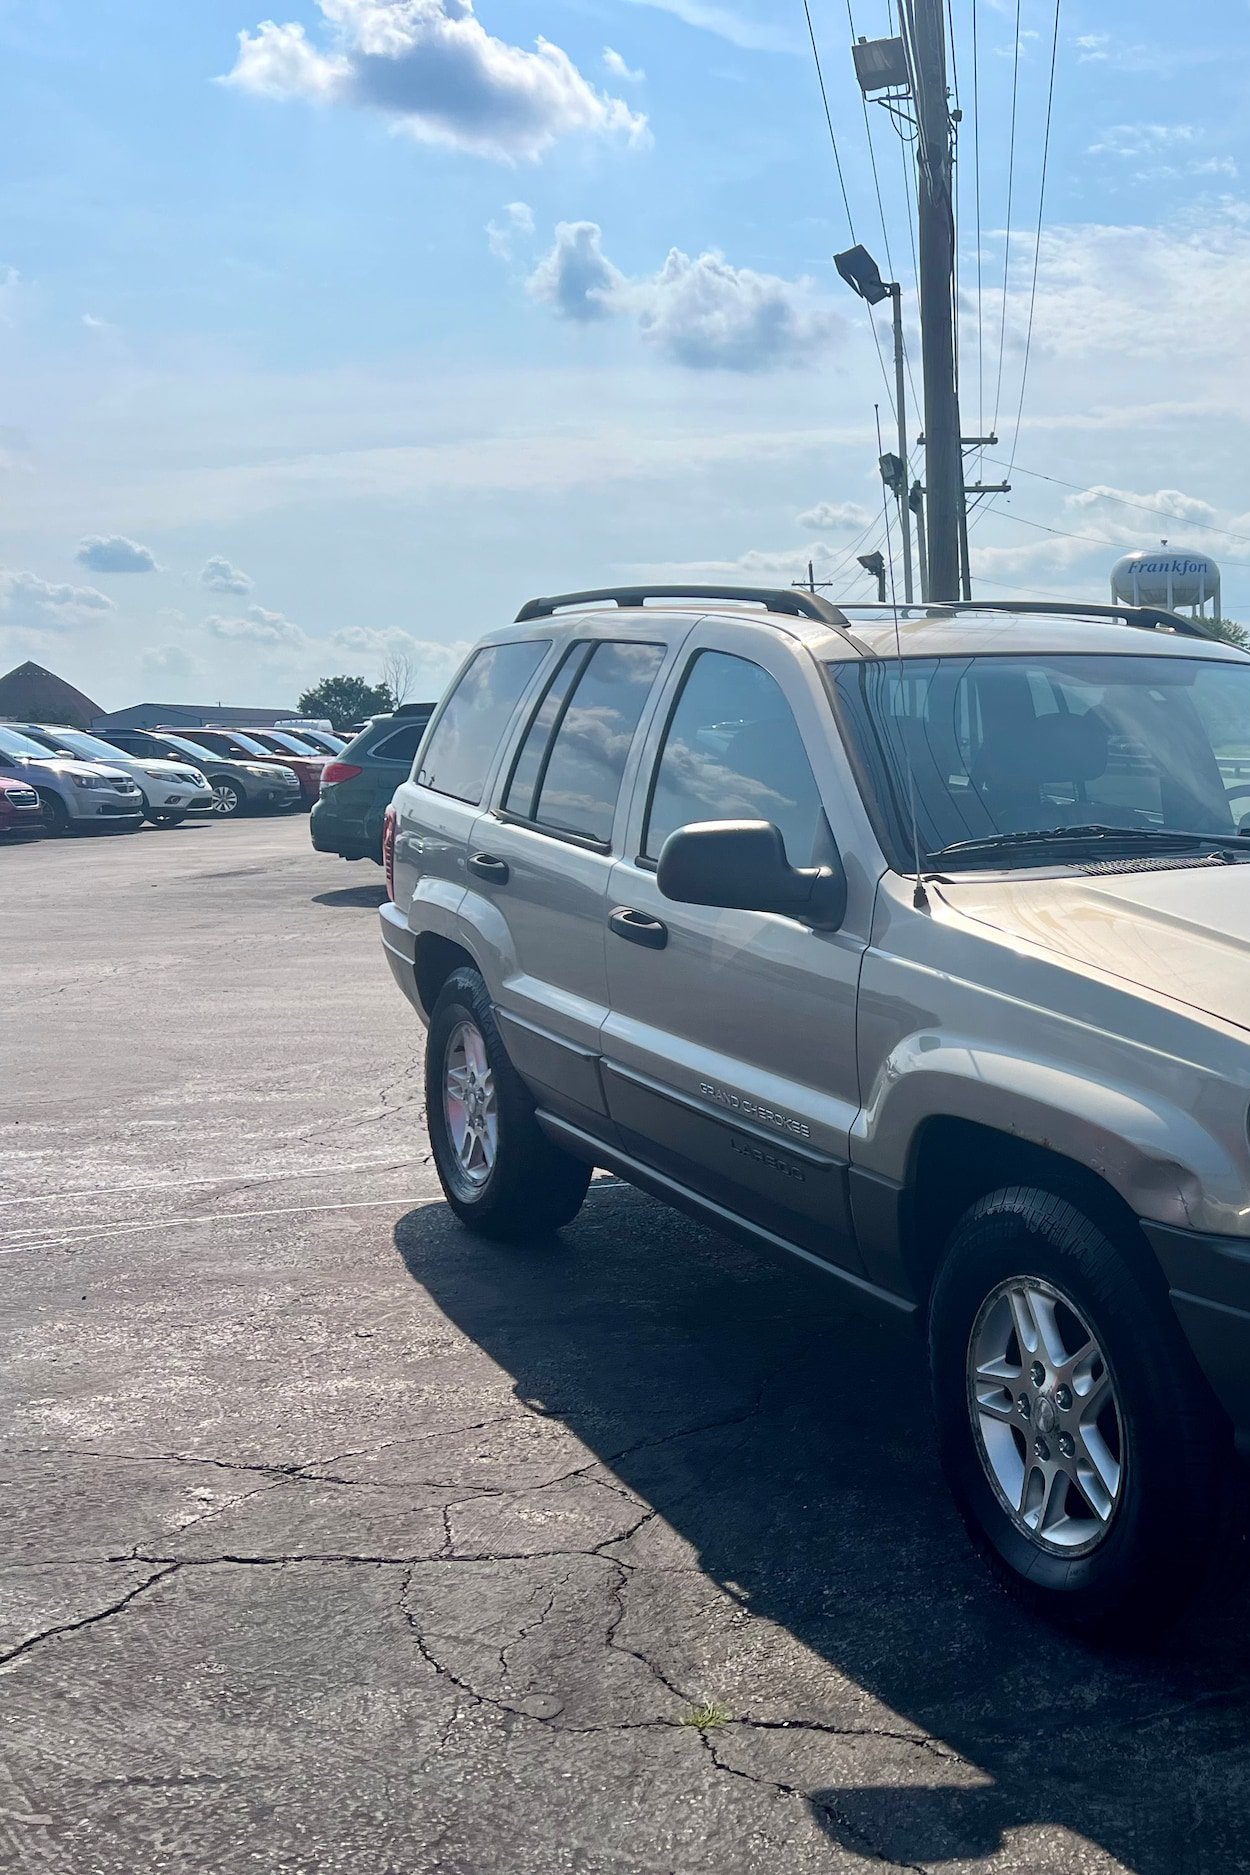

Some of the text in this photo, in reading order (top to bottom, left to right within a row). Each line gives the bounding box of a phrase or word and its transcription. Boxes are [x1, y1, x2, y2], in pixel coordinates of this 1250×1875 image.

[699, 1082, 811, 1138] GRAND CHEROKEE
[730, 1137, 806, 1184] LAREDO
